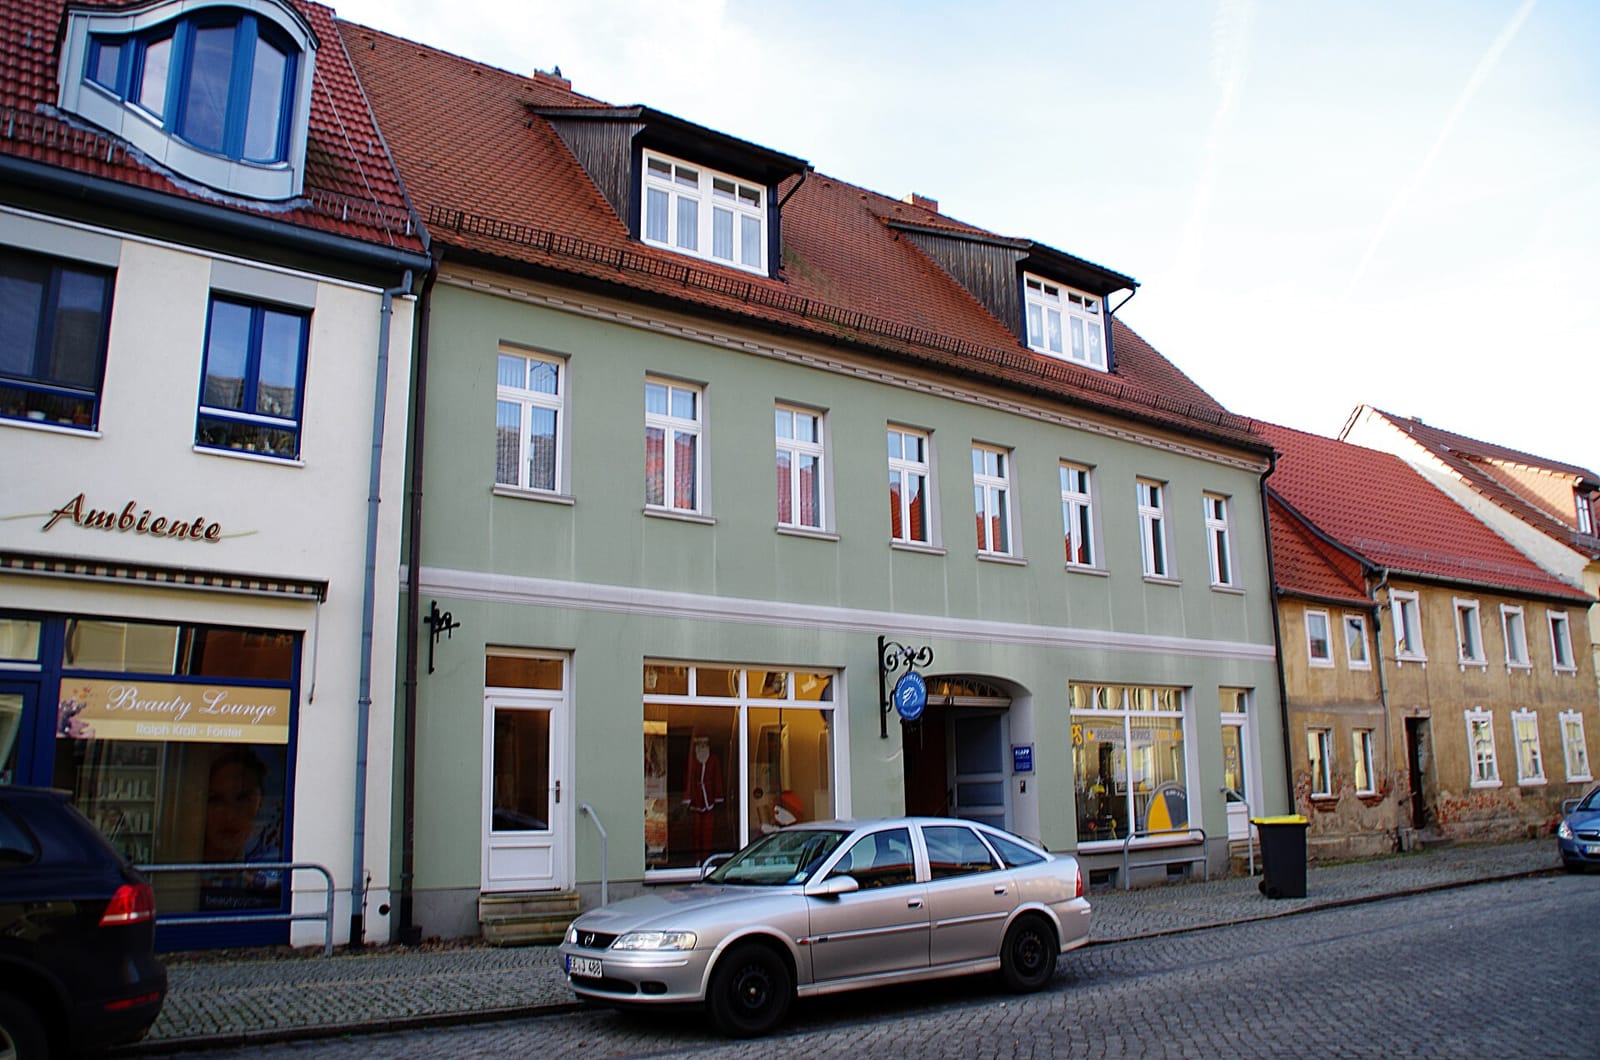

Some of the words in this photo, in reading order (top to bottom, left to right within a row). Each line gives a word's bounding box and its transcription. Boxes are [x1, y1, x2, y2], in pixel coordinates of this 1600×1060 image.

[41, 492, 222, 543] Ambiente
[105, 684, 193, 721] Beauty
[198, 688, 278, 725] Lounge
[136, 721, 169, 736] Ralph
